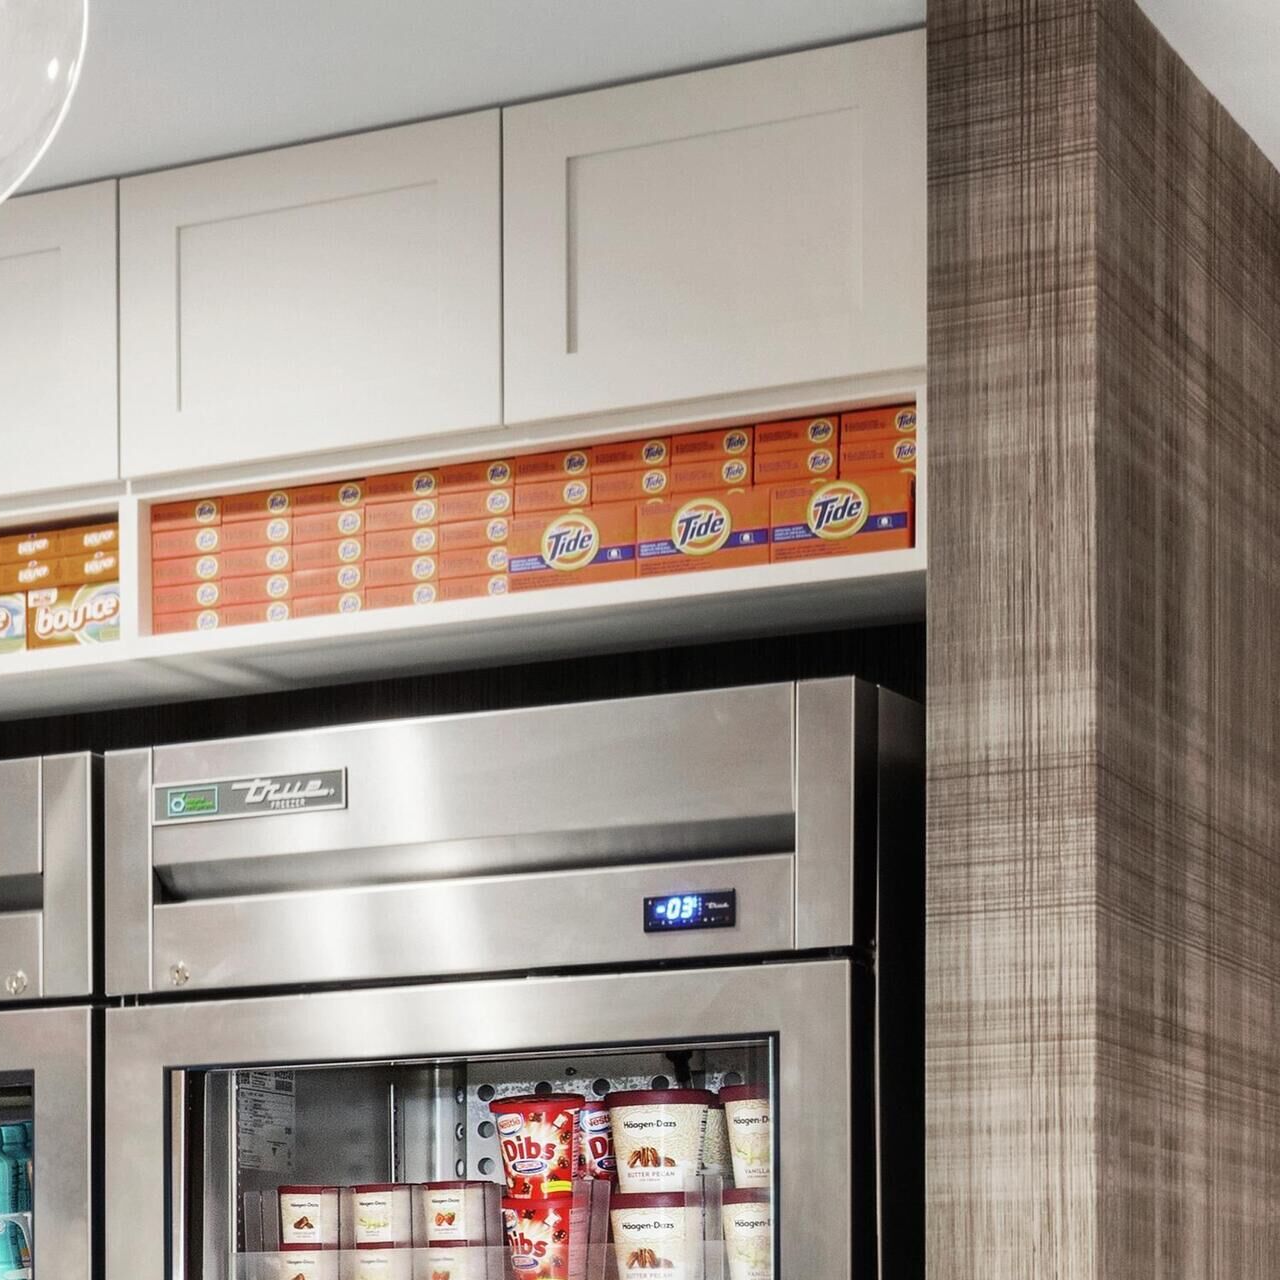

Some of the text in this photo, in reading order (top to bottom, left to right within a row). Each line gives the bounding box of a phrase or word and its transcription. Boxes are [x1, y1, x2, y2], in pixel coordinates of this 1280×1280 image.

[644, 446, 664, 460] Tide
[726, 435, 746, 449] Tide
[566, 456, 585, 470] Tide
[814, 496, 862, 531] Tide
[678, 513, 724, 546] Tide
[548, 529, 593, 562] Tide
[36, 595, 120, 639] bounce
[271, 799, 306, 809] FREEZER
[503, 1136, 556, 1162] Dibs
